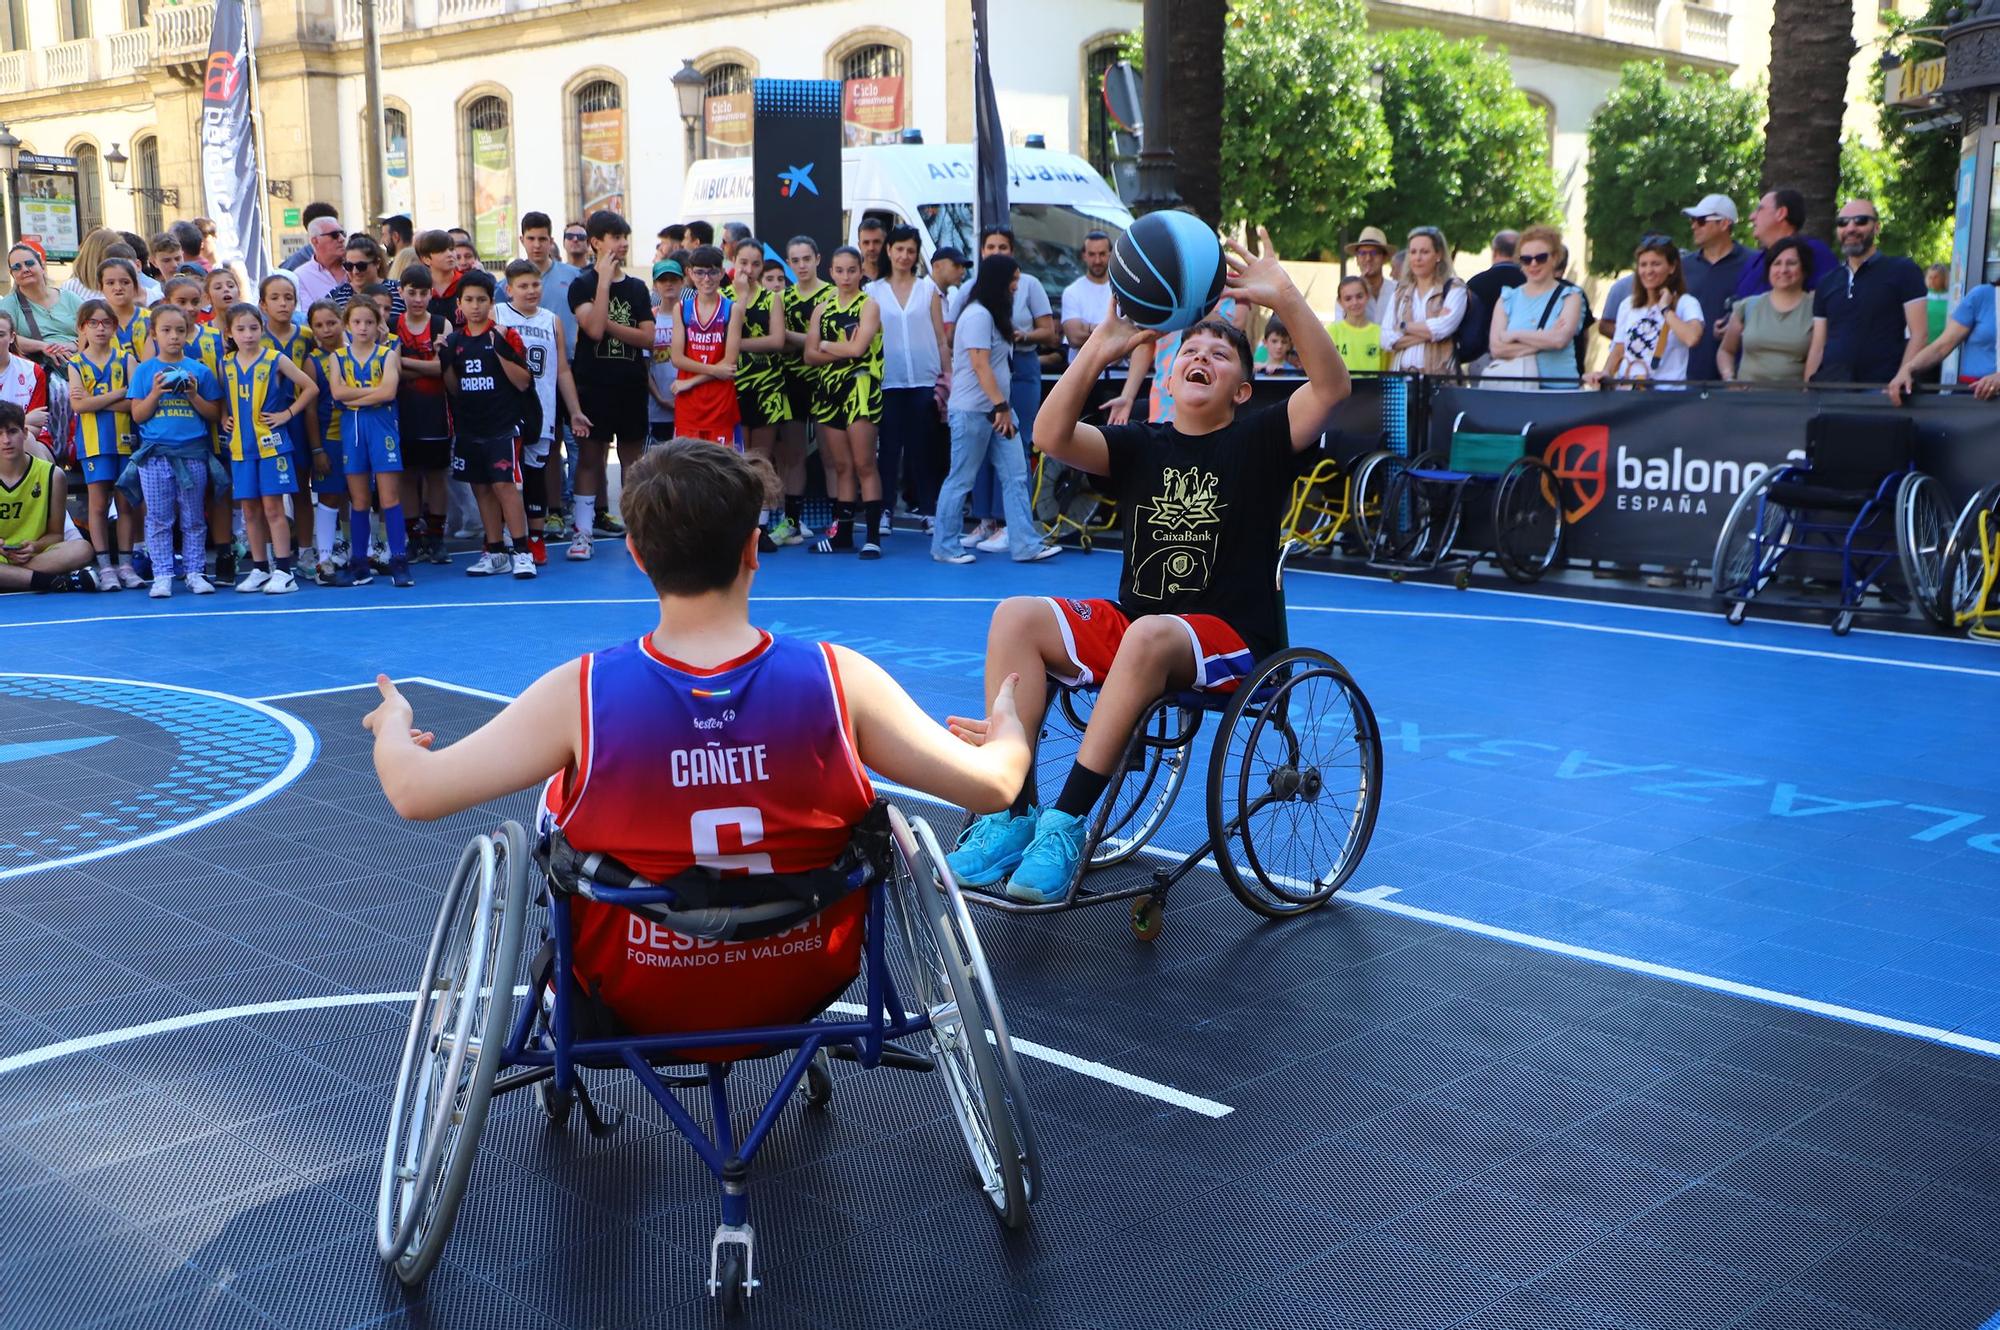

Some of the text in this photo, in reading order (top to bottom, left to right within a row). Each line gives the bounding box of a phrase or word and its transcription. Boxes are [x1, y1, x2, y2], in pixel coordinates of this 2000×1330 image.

[853, 82, 878, 97] Ciclo
[694, 176, 755, 200] AMBULANC
[513, 324, 552, 340] TROIT
[688, 327, 726, 344] ARISTA
[465, 359, 482, 373] 23
[461, 377, 495, 391] CABRA
[239, 384, 250, 402] 4
[453, 456, 466, 471] 23
[0, 502, 23, 520] 27
[1616, 494, 1708, 515] ESPAÑA
[1152, 529, 1212, 542] CaixaBank
[671, 741, 769, 788] CAÑETE
[627, 934, 823, 968] FORMANDO EN VALORES
